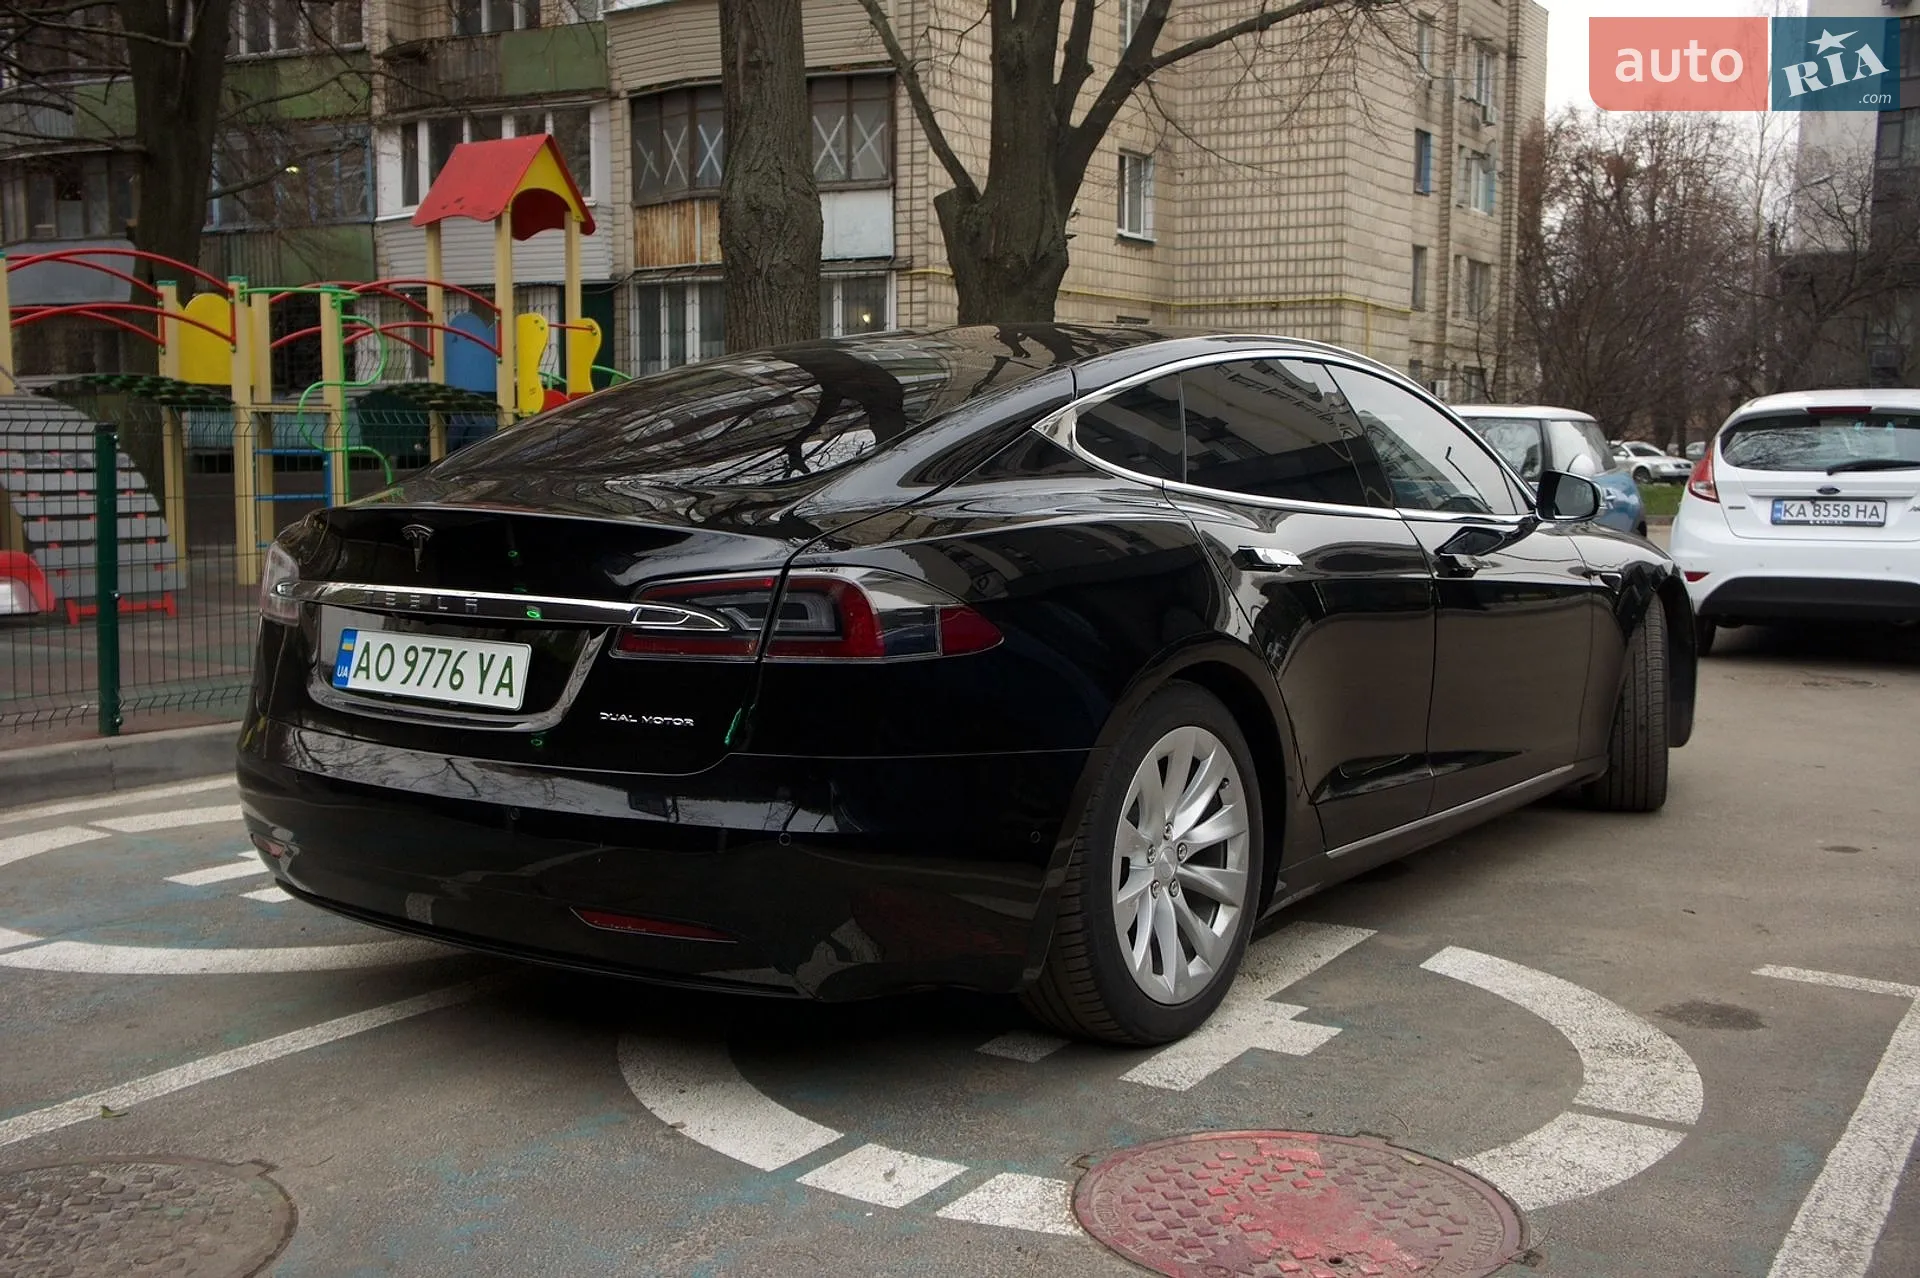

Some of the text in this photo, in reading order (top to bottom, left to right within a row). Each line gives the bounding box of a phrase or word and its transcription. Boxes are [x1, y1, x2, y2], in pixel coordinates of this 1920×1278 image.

[1783, 503, 1880, 520] KA 8558 HA
[336, 665, 349, 679] UA
[352, 641, 514, 698] AO 9776 YA
[600, 711, 695, 727] DUAL MOTOR
